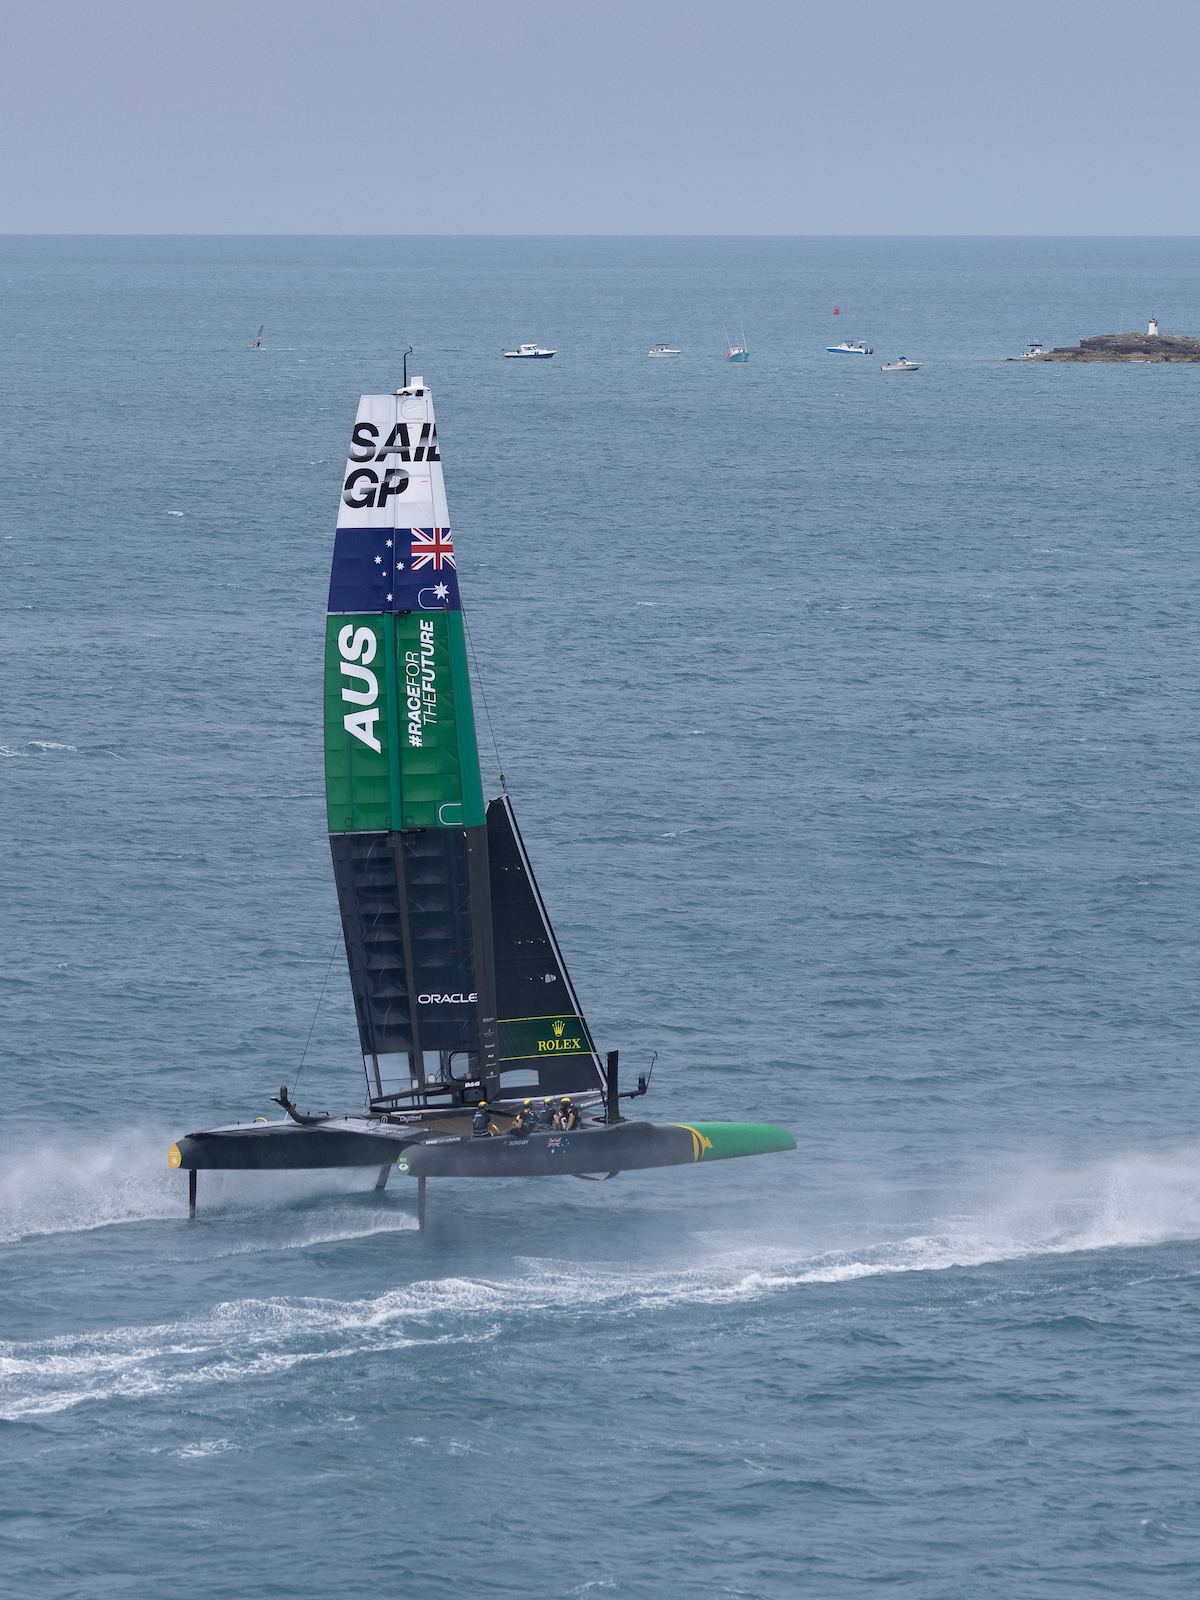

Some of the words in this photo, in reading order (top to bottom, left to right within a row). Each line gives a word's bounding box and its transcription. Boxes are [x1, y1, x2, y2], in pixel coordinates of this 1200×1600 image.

[349, 422, 441, 463] SAIL
[343, 468, 411, 509] GP
[337, 624, 382, 754] AUS
[419, 619, 437, 726] THEFUTURE
[417, 992, 478, 1004] ORACLE
[538, 1038, 581, 1051] ROLEX
